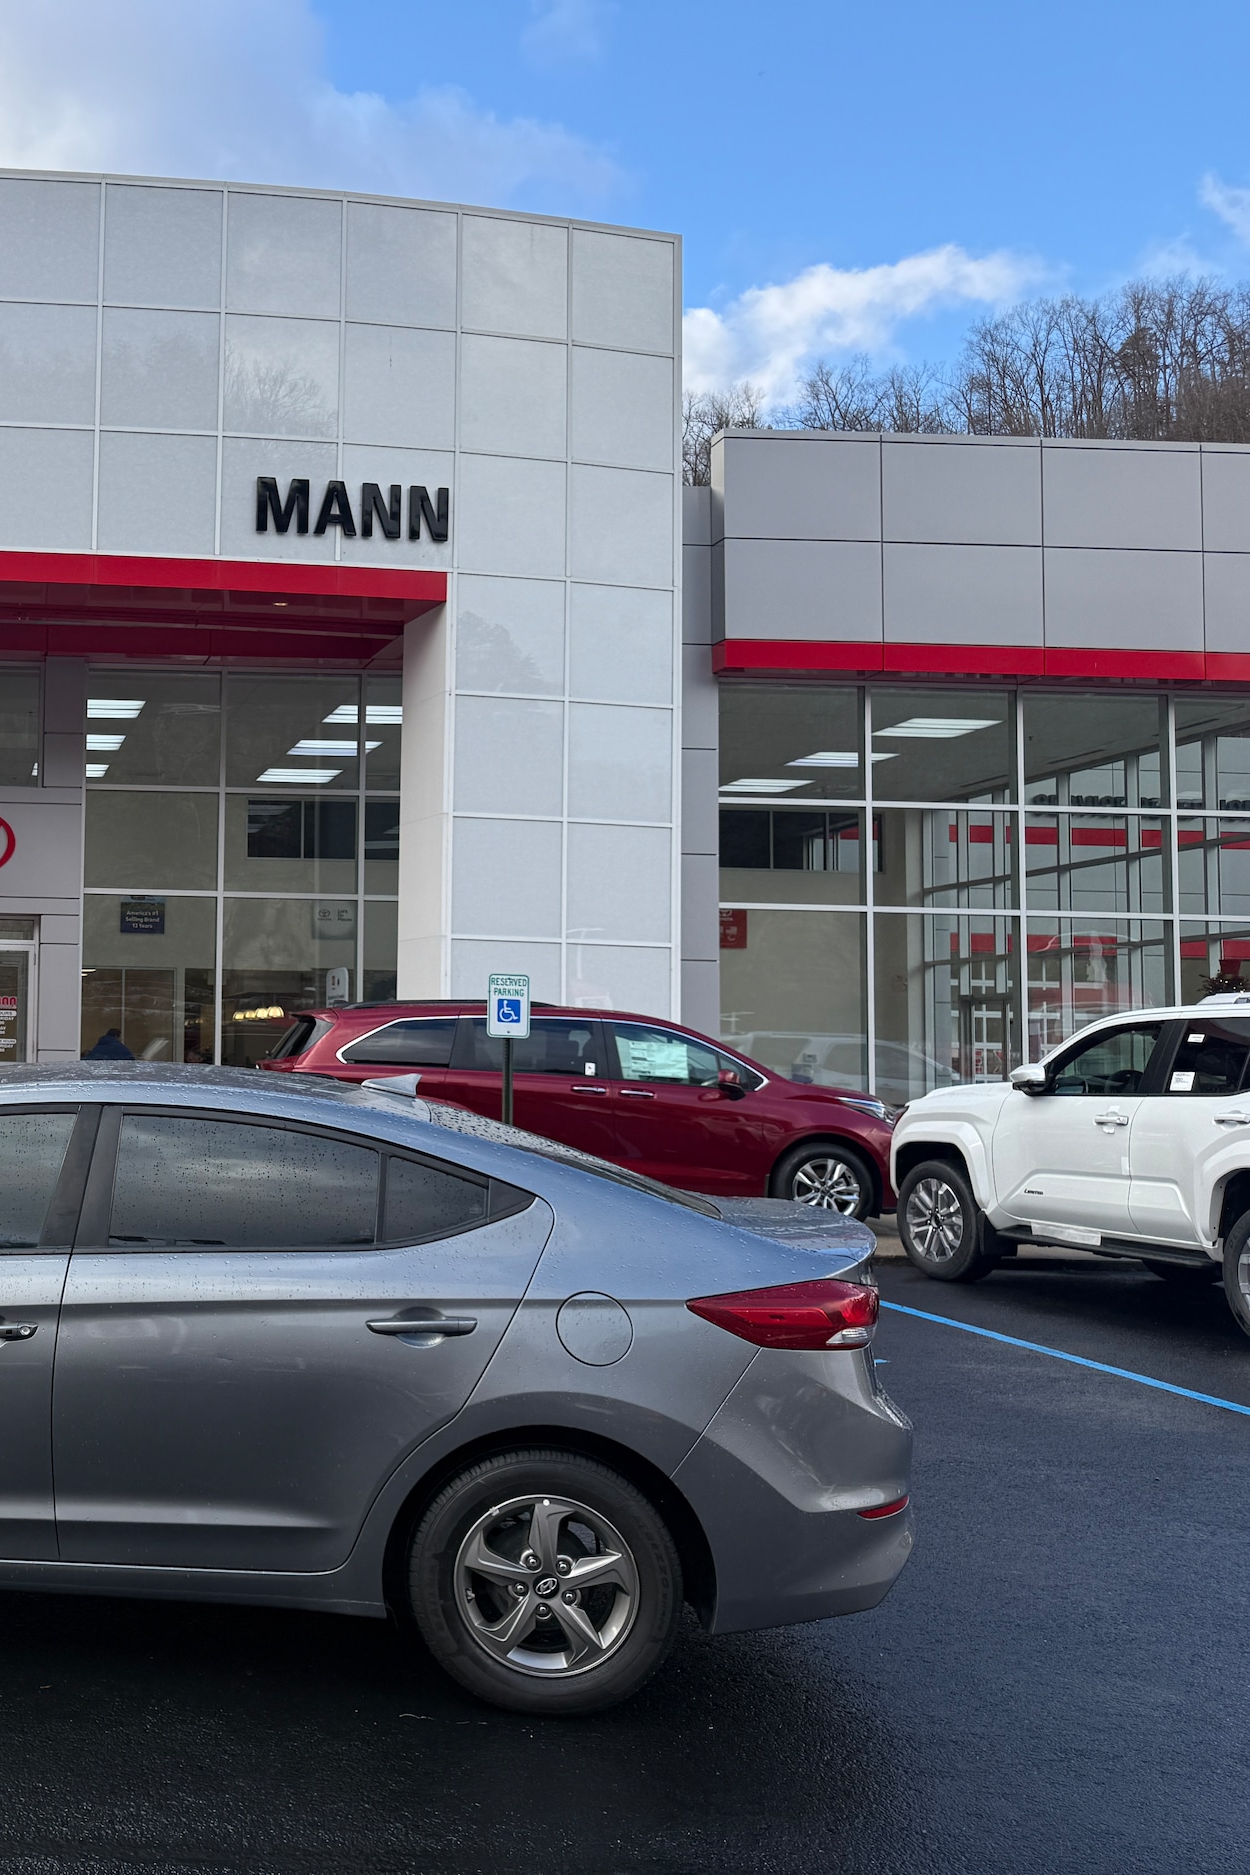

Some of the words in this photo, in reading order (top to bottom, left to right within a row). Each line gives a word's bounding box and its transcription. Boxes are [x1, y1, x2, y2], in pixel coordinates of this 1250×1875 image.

[256, 477, 449, 541] MANN
[491, 977, 527, 987] RESERVED
[494, 988, 525, 997] PARKING
